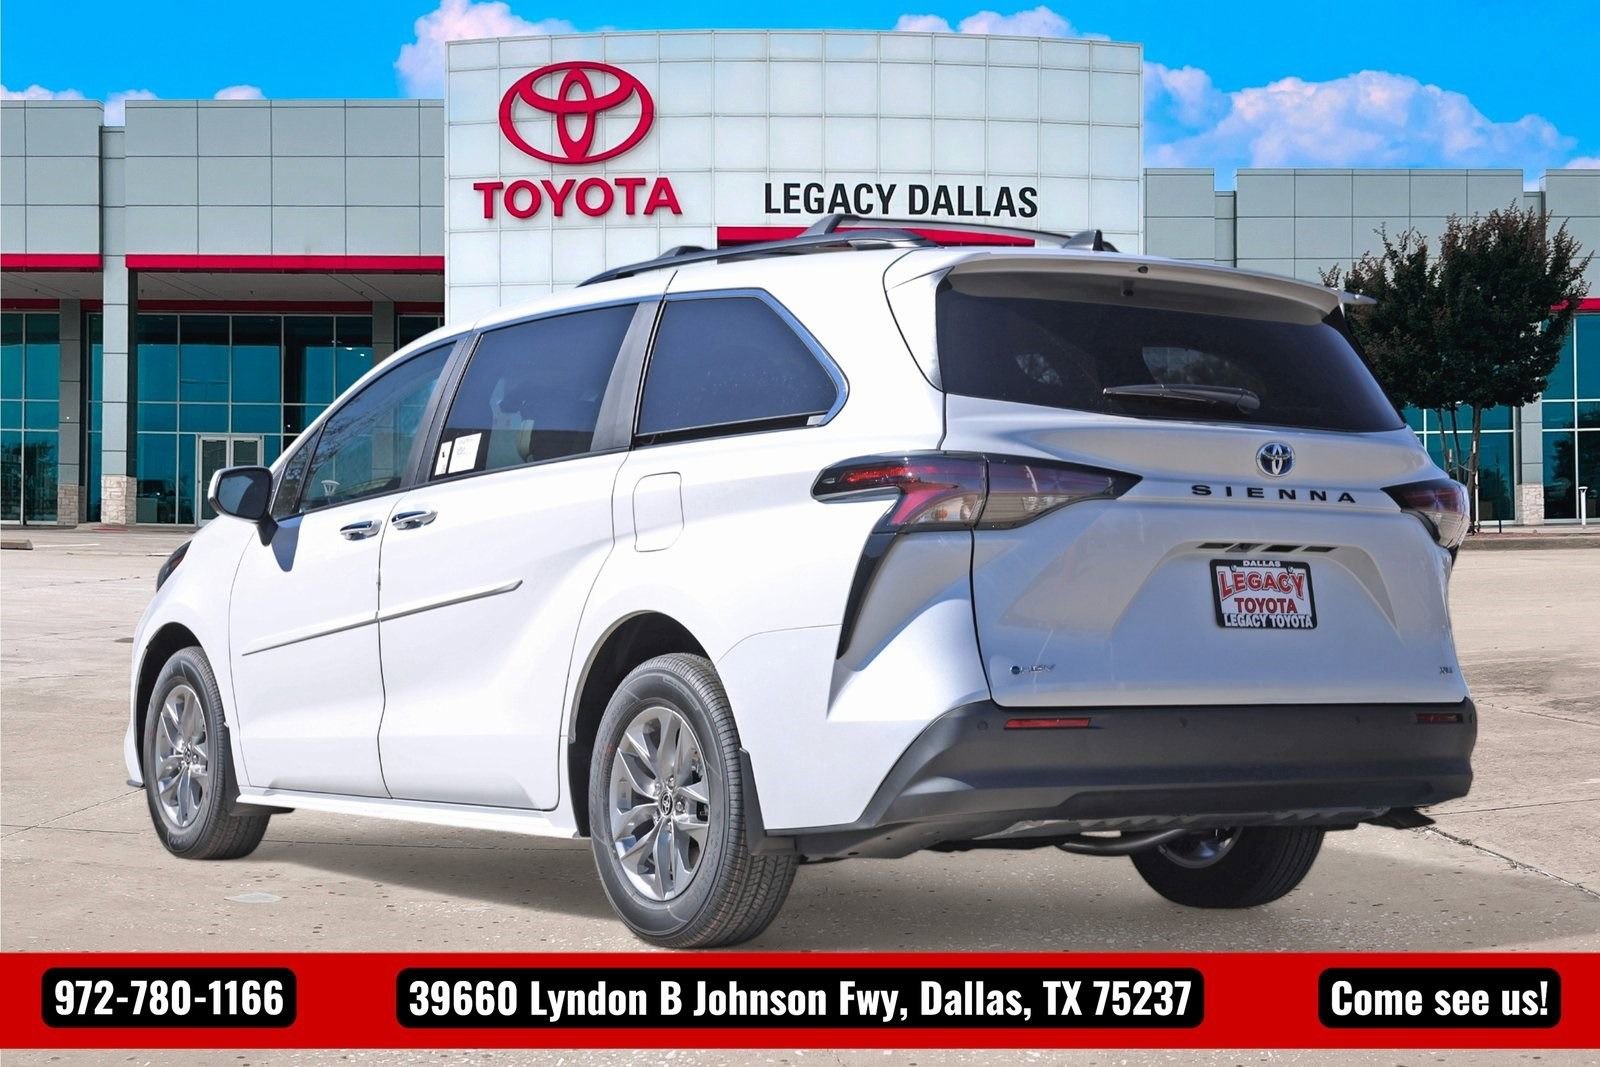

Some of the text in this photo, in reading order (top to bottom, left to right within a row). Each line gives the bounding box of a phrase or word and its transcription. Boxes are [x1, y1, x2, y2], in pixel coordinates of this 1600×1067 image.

[474, 177, 682, 219] TOYOTA
[764, 182, 1039, 218] LEGACY DALLAS
[1192, 484, 1356, 503] SIENNA
[1218, 571, 1304, 600] LEGACY
[1234, 597, 1298, 614] TOYOTA
[1224, 613, 1313, 628] LEGACY TOYOTA
